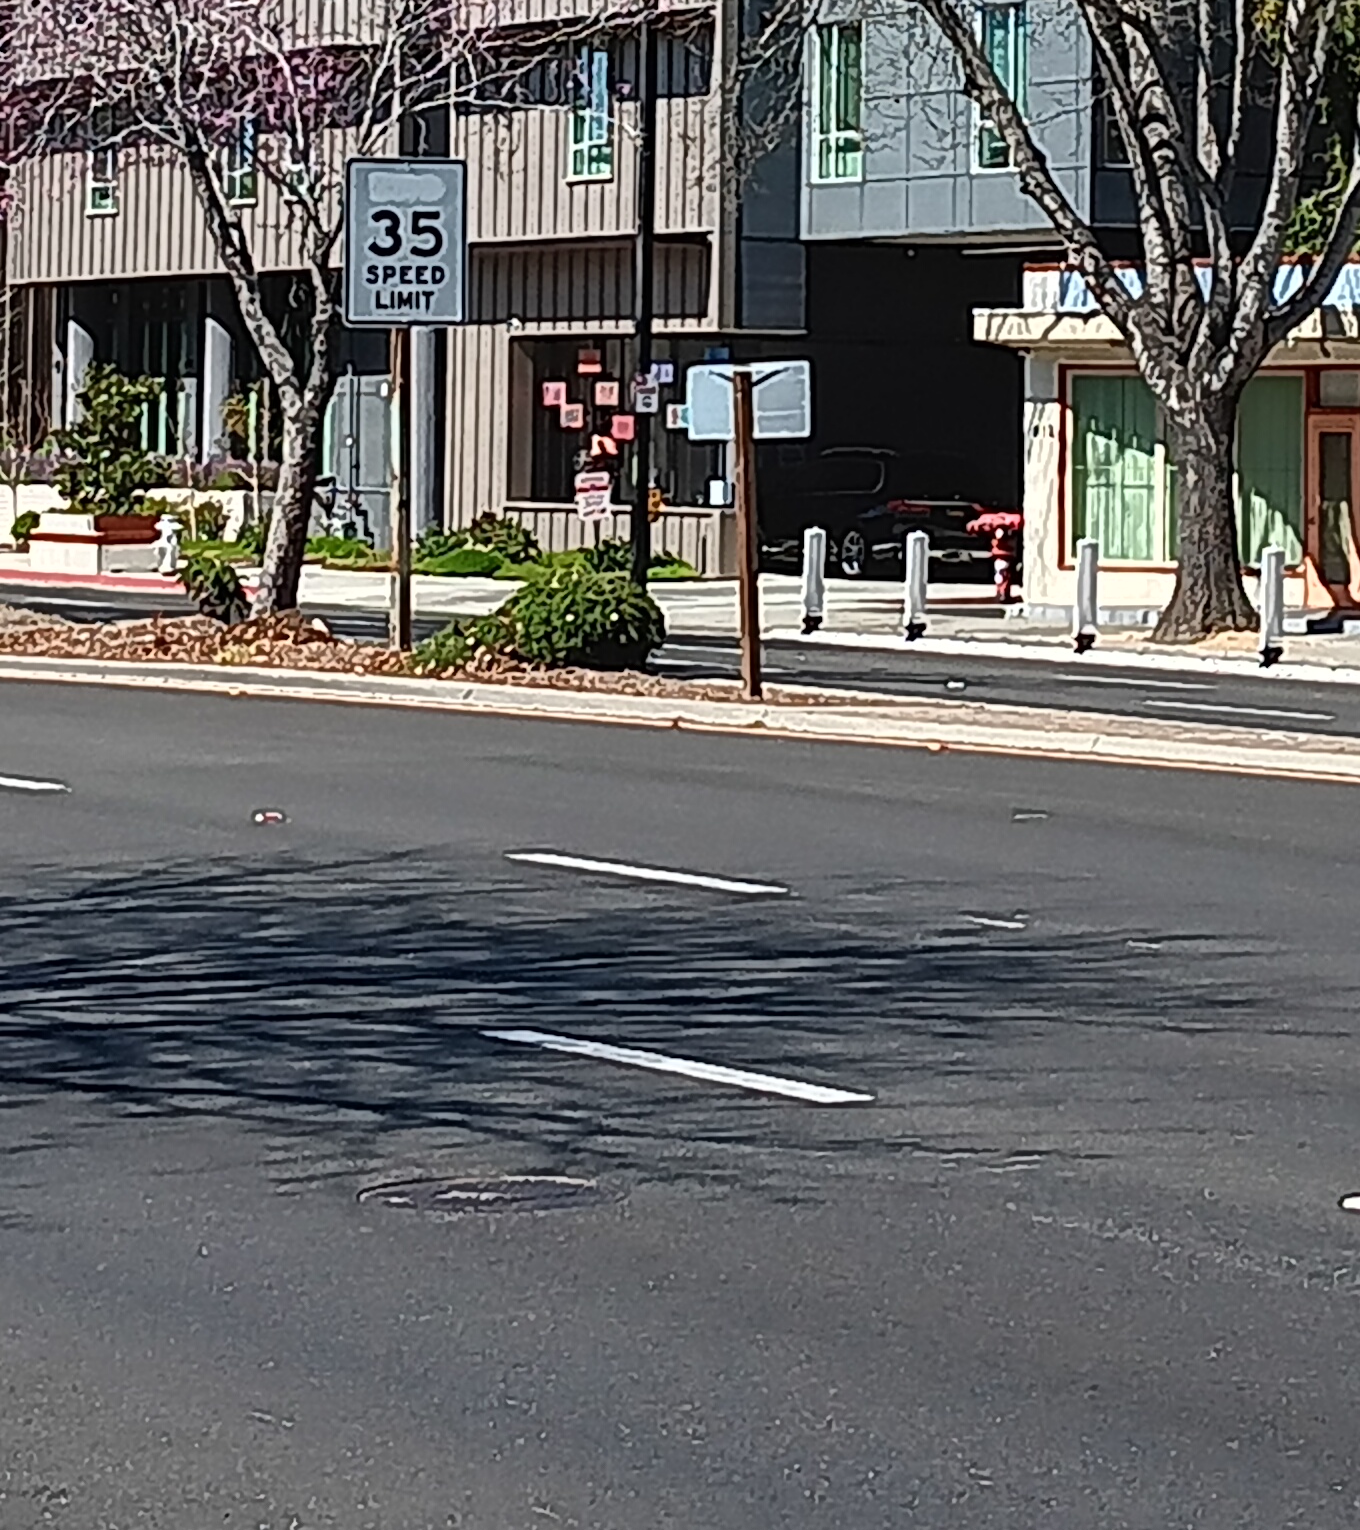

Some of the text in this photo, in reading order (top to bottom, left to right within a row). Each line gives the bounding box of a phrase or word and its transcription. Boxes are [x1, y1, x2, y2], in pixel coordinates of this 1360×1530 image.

[367, 208, 444, 258] 35
[365, 264, 446, 285] SPEED
[374, 289, 436, 313] LIMIT
